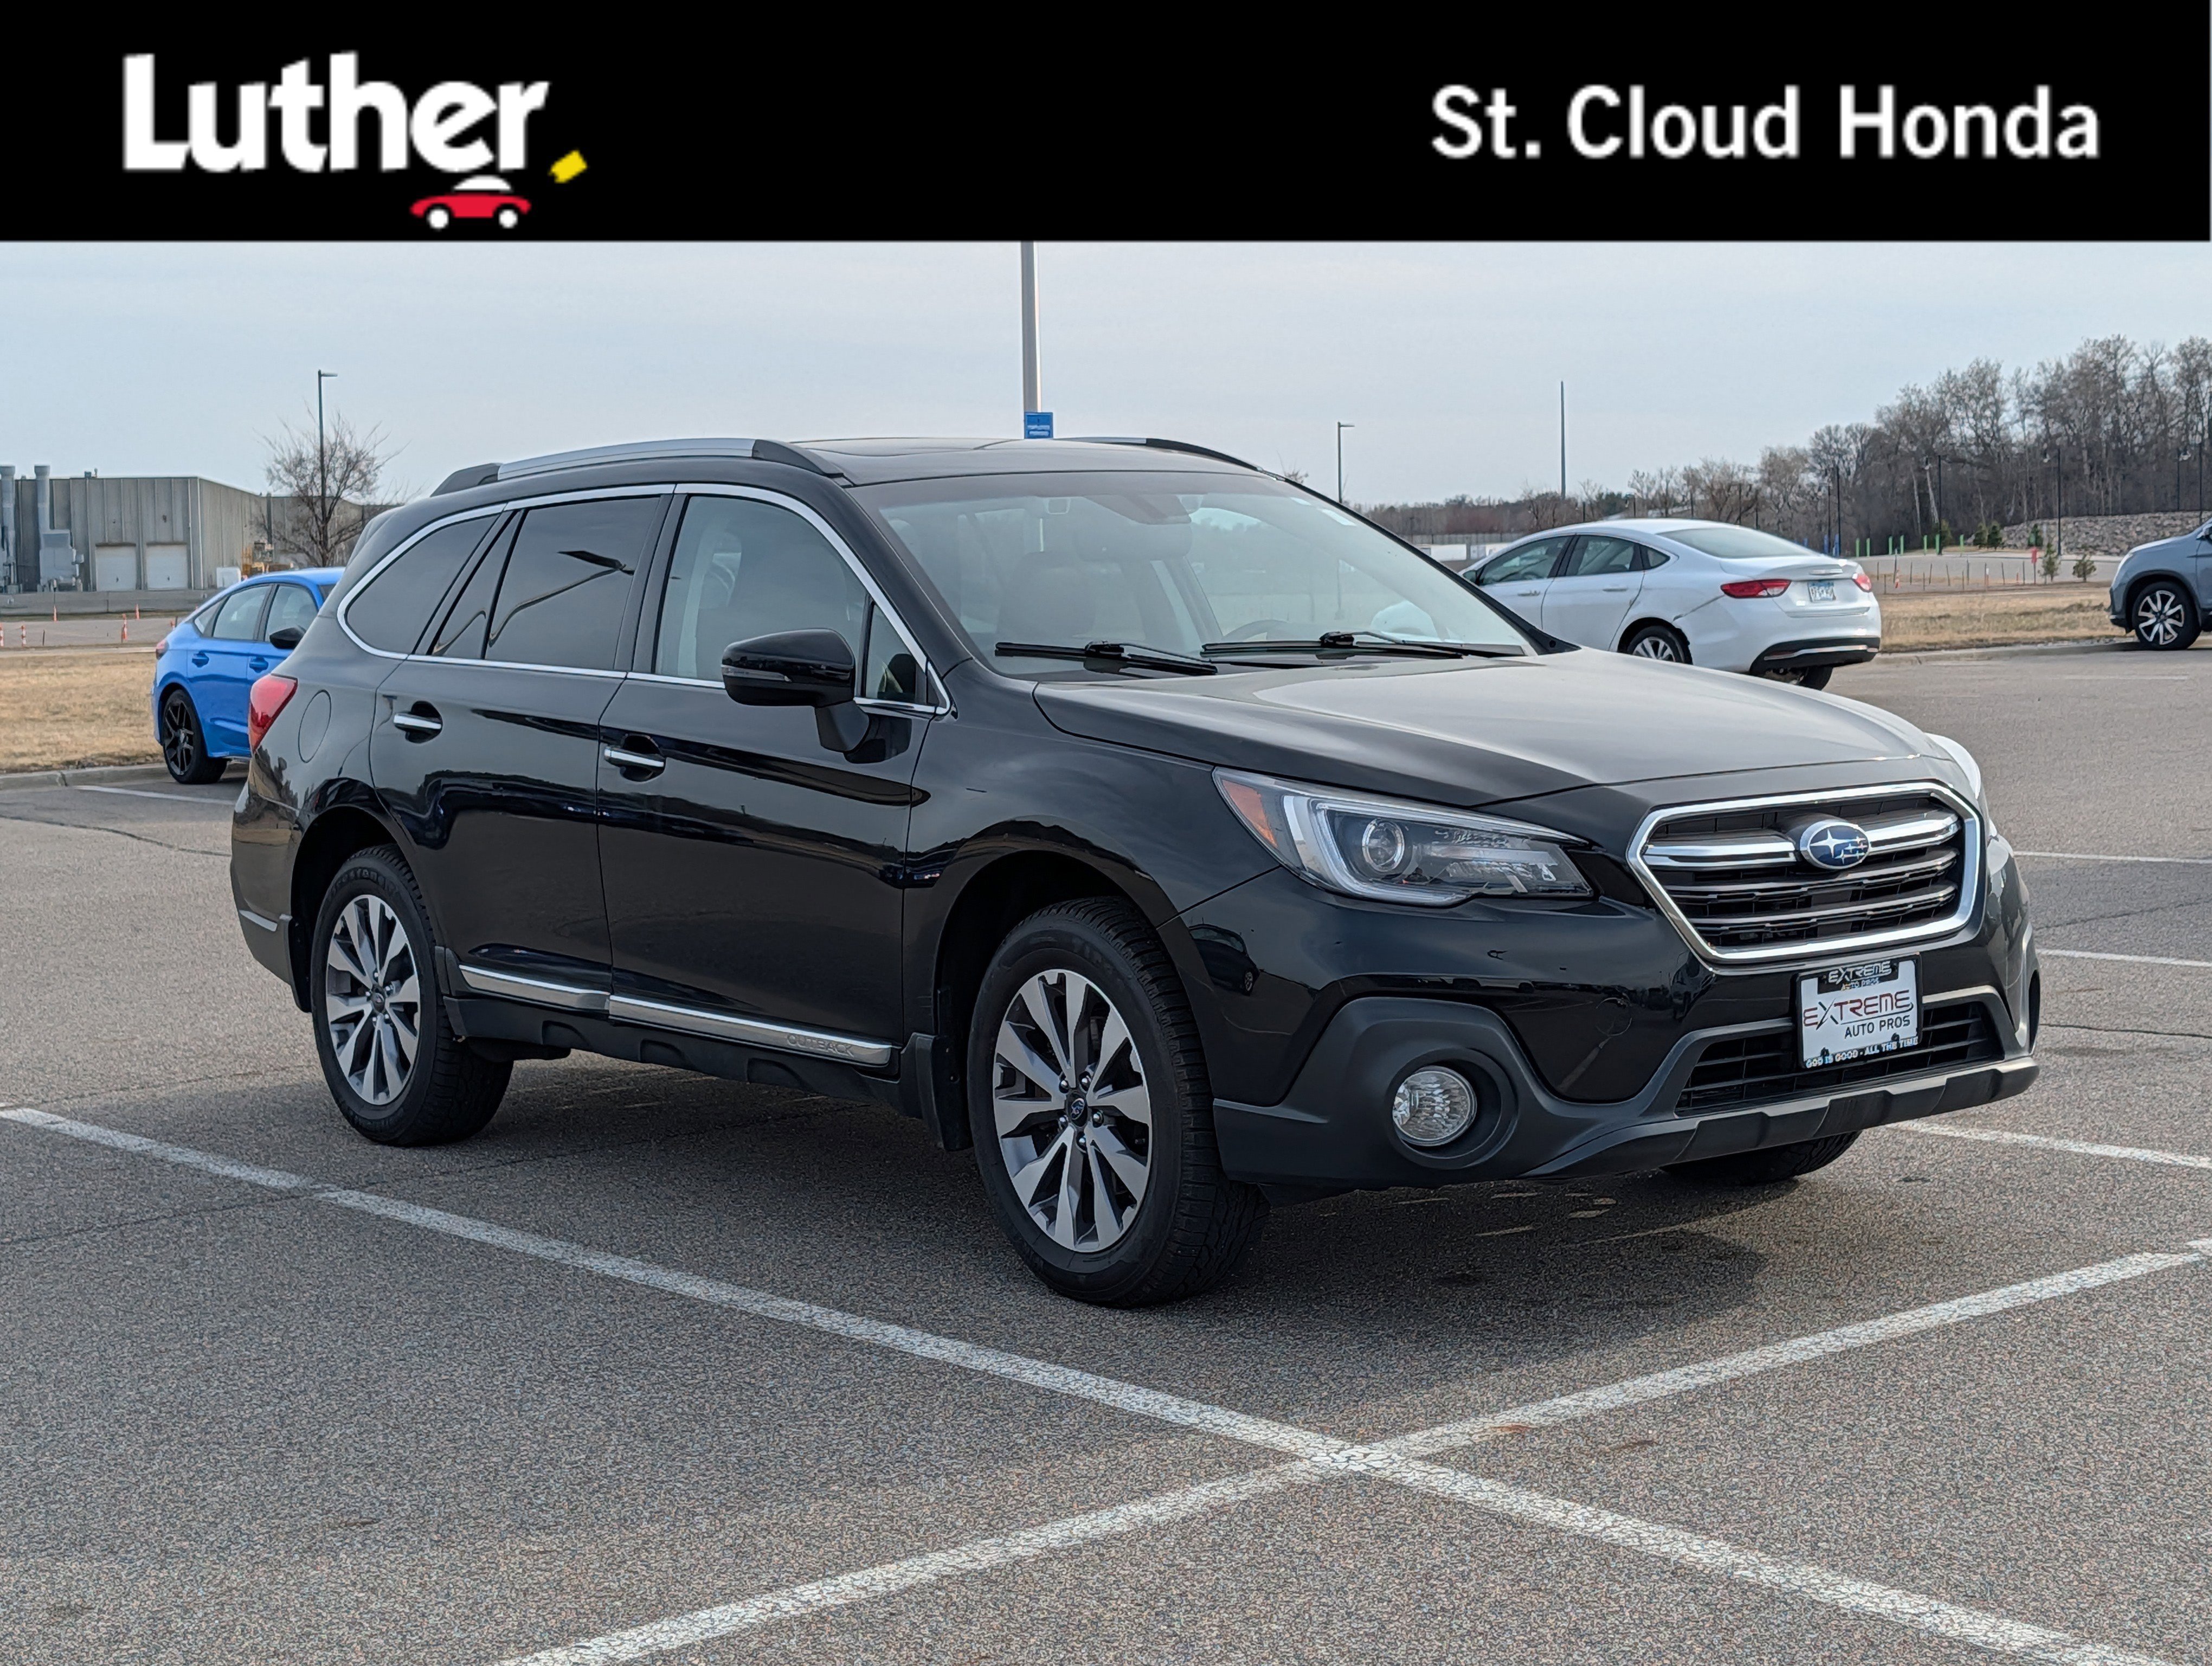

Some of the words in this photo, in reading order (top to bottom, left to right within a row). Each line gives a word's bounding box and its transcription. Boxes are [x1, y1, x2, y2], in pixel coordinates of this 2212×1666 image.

[1828, 960, 1892, 984] EXTREME
[1803, 989, 1914, 1030] EXTREME
[1844, 1022, 1875, 1039] AUTO
[1879, 1015, 1910, 1031] PROS
[1864, 1045, 1879, 1056] ALL
